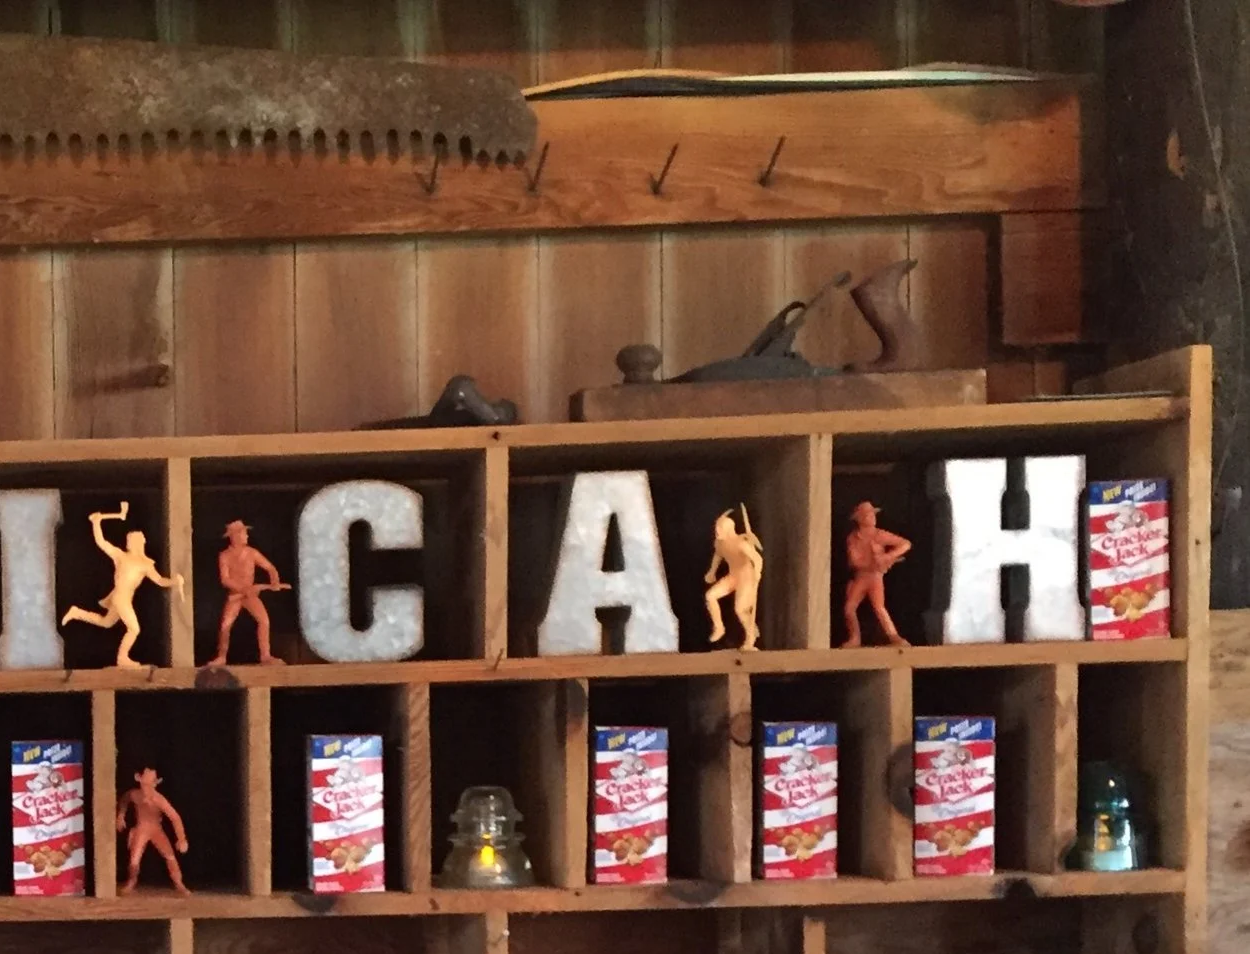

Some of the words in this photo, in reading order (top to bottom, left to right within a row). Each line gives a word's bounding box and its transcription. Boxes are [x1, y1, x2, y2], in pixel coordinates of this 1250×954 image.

[1102, 529, 1161, 550] Cracker
[1116, 544, 1148, 564] Jack
[775, 772, 832, 792] Cracker
[926, 767, 986, 786] Cracker
[323, 785, 377, 804] Cracker
[606, 777, 662, 796] Cracker
[788, 788, 819, 804] Jack
[940, 782, 974, 799] Jack
[22, 789, 78, 808] Cracker
[619, 792, 649, 809] Jack
[35, 804, 66, 822] Jack
